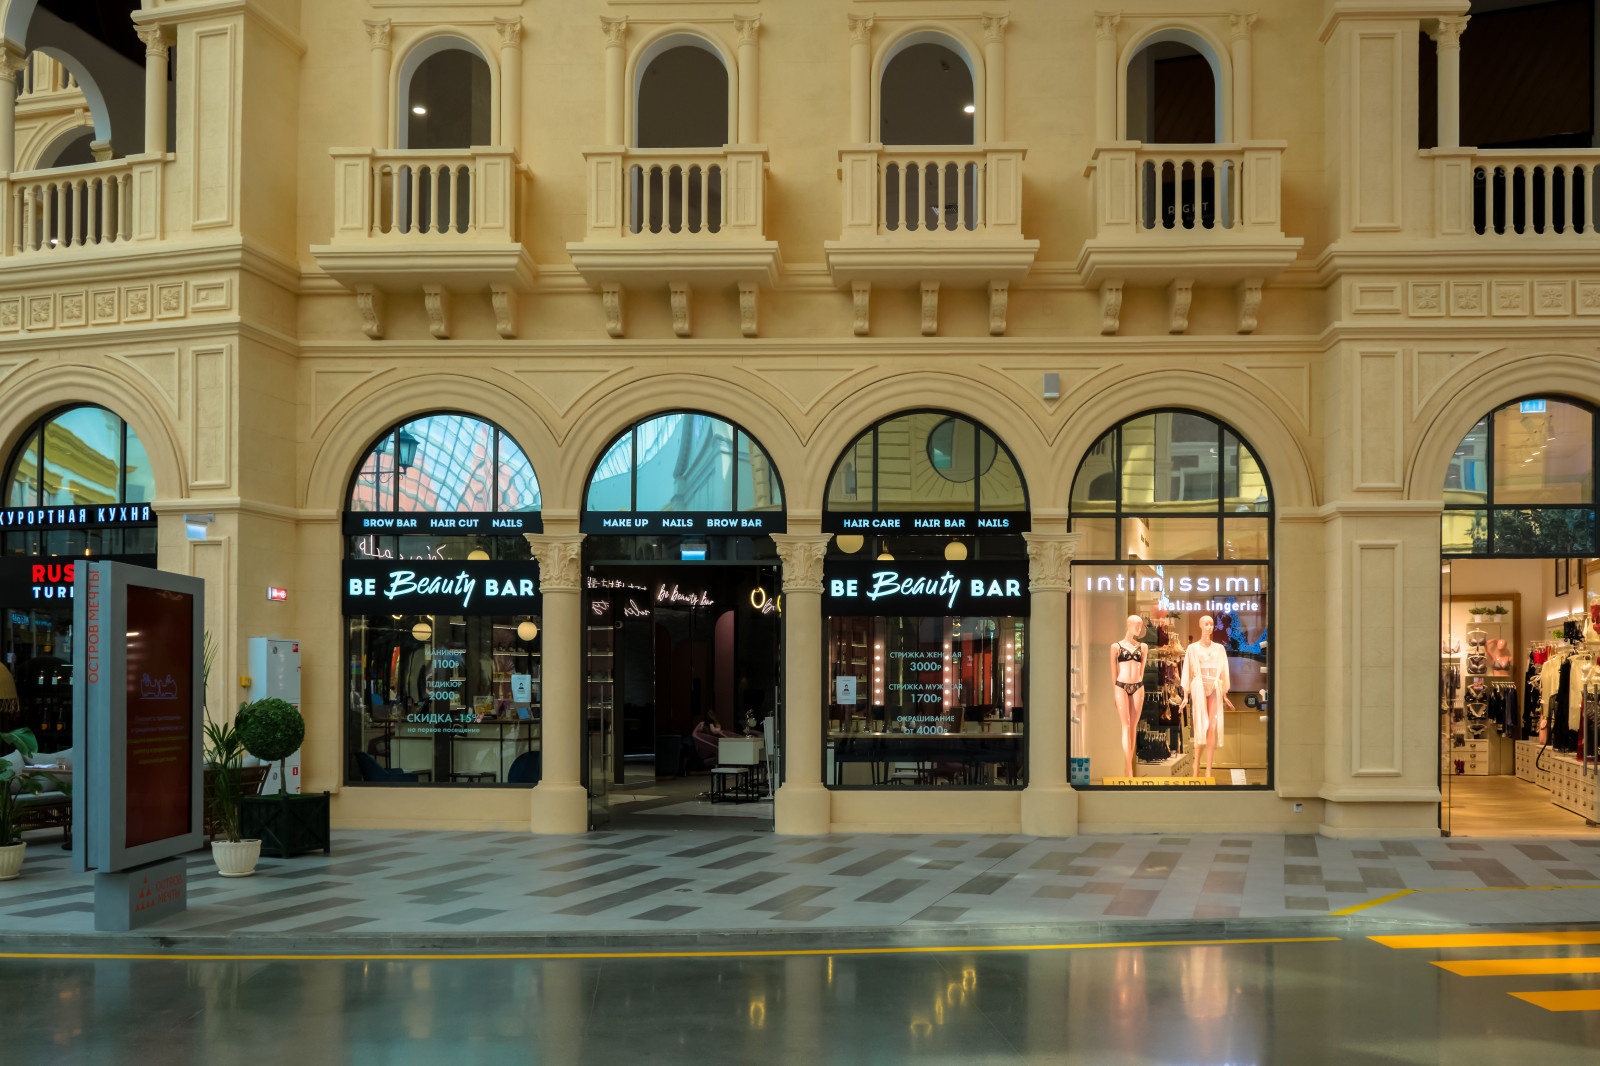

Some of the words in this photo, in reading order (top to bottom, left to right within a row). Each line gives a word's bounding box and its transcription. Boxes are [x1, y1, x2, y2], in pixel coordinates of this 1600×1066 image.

[98, 506, 150, 521] КУХНЯ
[363, 518, 394, 528] BROW
[396, 518, 418, 528] BAR
[430, 518, 456, 528] HAIR
[458, 518, 480, 528] CUT
[492, 518, 523, 528] NAILS
[602, 518, 632, 527] MAKE
[634, 518, 649, 527] UP
[662, 518, 693, 527] NAILS
[707, 518, 739, 527] BROW
[740, 518, 762, 527] BAR
[843, 518, 870, 528] HAIR
[872, 518, 901, 528] CARE
[914, 518, 941, 528] HAIR
[944, 518, 965, 528] BAR
[977, 518, 1010, 528] NAILS
[1087, 574, 1260, 592] intimissimi
[349, 578, 376, 596] BE
[384, 570, 476, 608] Beauty
[485, 578, 534, 596] BAR
[830, 579, 858, 597] BE
[866, 570, 961, 609] Beauty
[970, 579, 1021, 597] BAR
[88, 570, 100, 621] МЕЧТЫ
[1206, 600, 1259, 613] lingerie
[88, 624, 100, 684] ОСТРОВ
[889, 651, 925, 659] СТРИЖКА
[888, 683, 924, 691] СТРИЖКА
[406, 713, 453, 725] СКИДКА
[454, 713, 481, 723] -15%
[155, 874, 183, 891] ОСТРОВ
[157, 888, 181, 905] МЕЧТЫ
